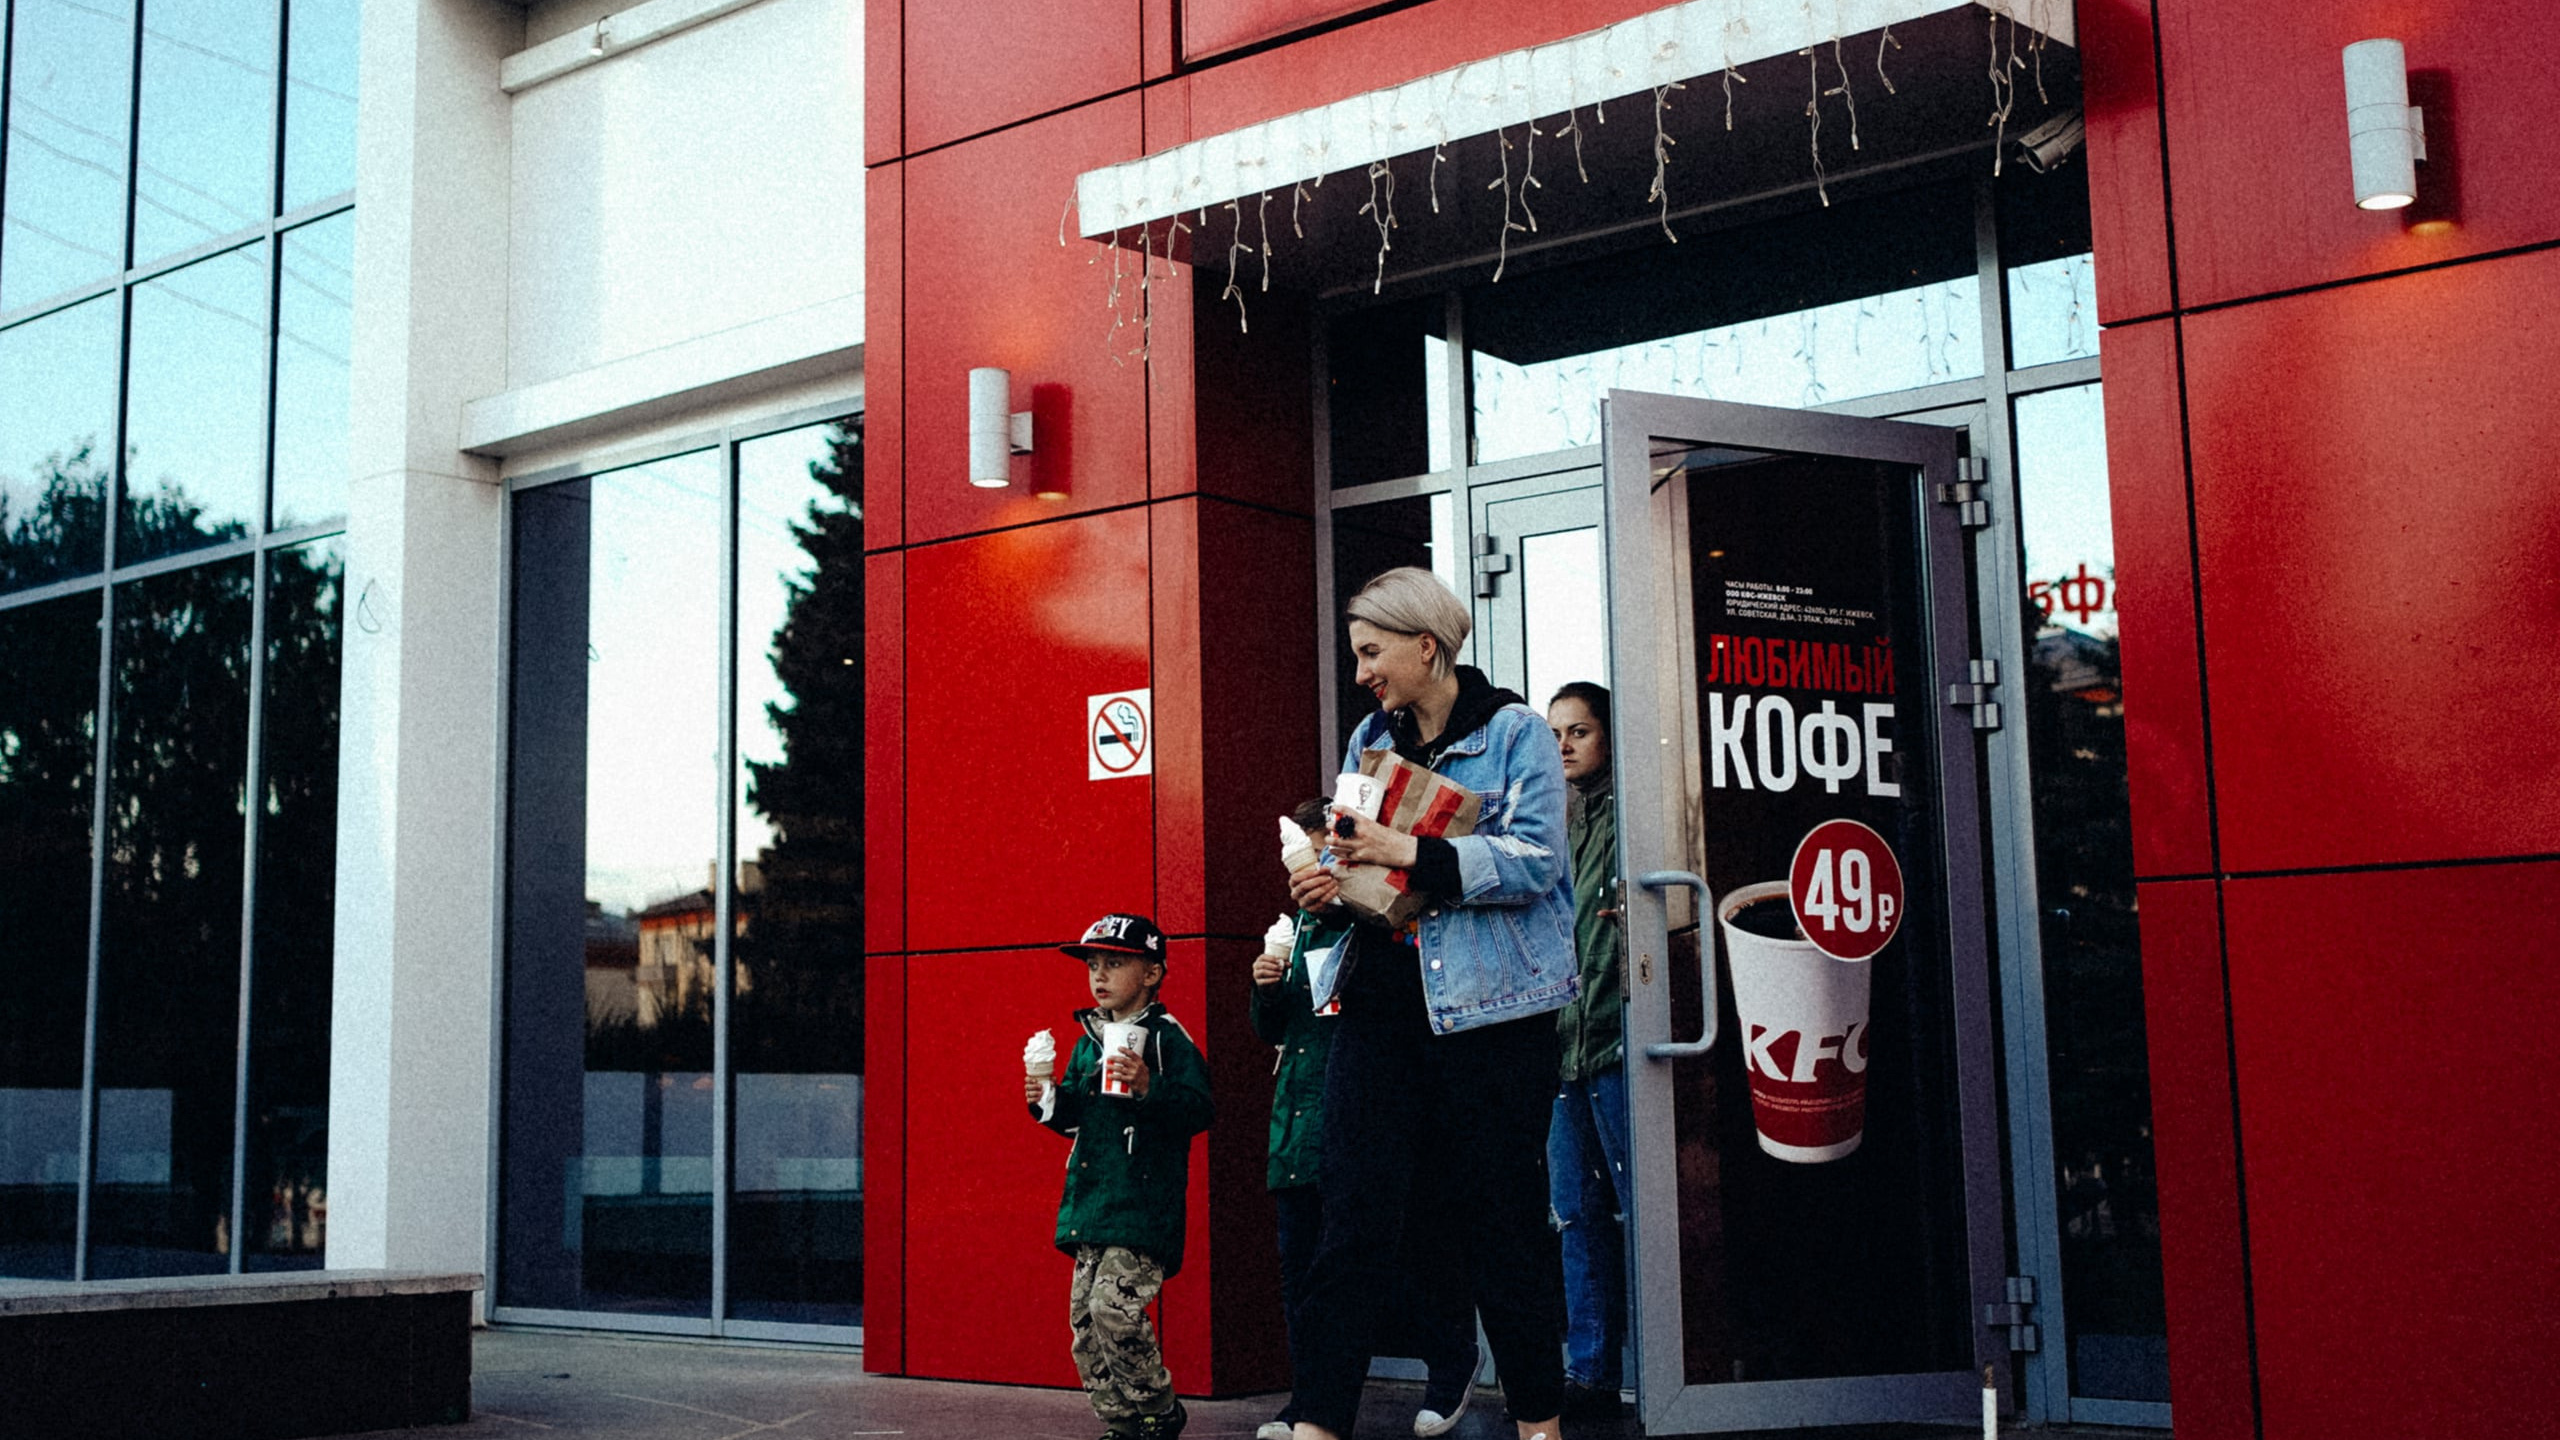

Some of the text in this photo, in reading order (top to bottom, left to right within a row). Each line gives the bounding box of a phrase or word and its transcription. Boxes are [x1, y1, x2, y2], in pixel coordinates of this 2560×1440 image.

[1725, 580, 1744, 589] ЧАСЫ
[1795, 586, 1813, 595] 23:00
[1726, 589, 1739, 598] ООО
[1726, 599, 1778, 610] ЮРИДИЧЕСКИЙ
[1824, 617, 1842, 625] ОФИС
[1707, 634, 1895, 694] ЛЮБИМЫЙ
[1709, 692, 1900, 798] КОФЕ
[1741, 1020, 1868, 1083] KFC
